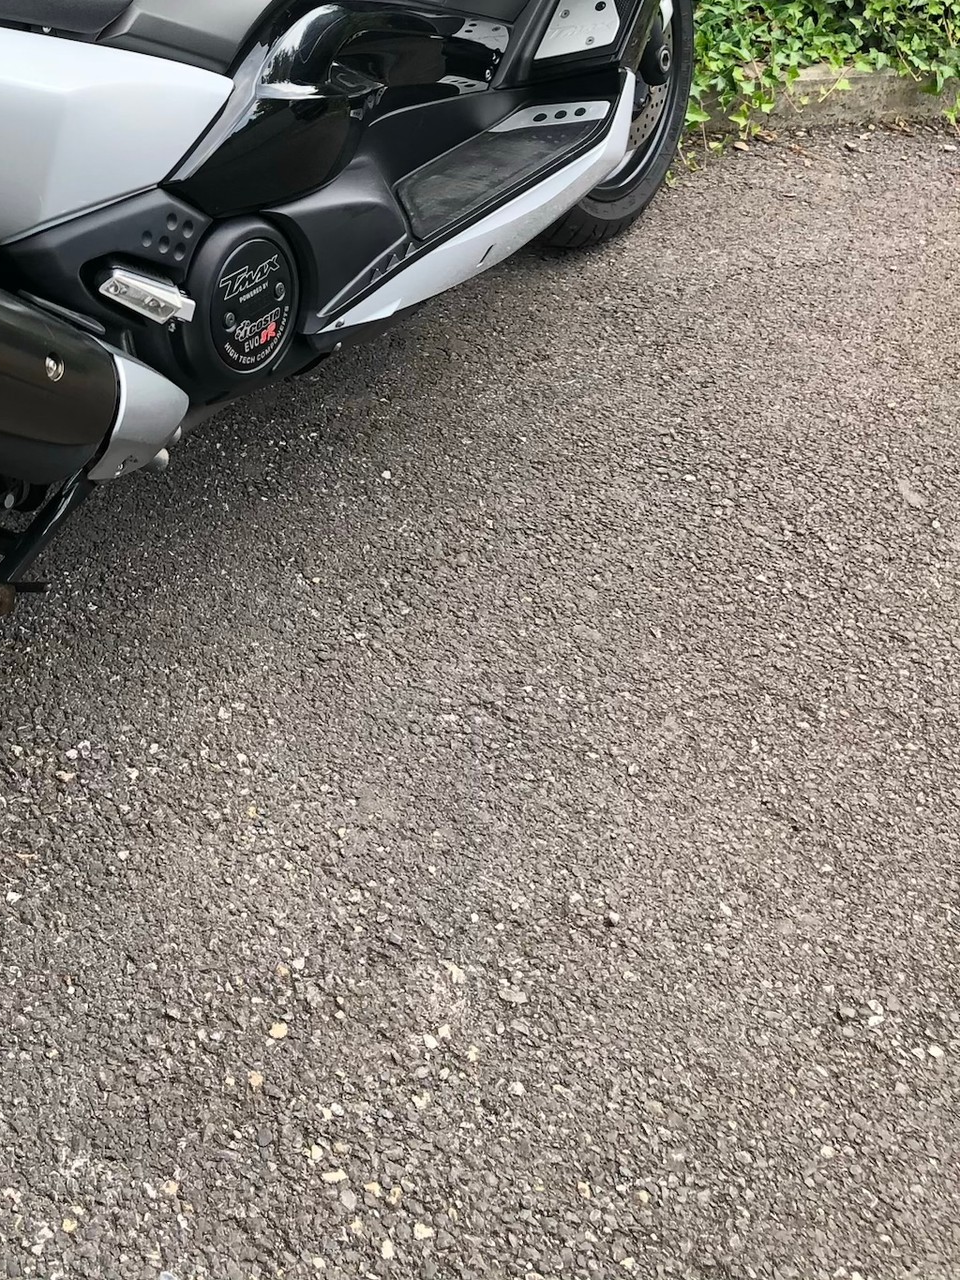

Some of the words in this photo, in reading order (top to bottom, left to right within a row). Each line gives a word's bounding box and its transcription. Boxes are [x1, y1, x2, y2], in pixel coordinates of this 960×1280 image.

[219, 254, 280, 301] TMAX
[239, 285, 263, 303] POWERED
[262, 280, 269, 291] BY
[224, 342, 239, 361] HIGH
[239, 355, 256, 365] TECH
[256, 305, 290, 361] COMPONENTS
